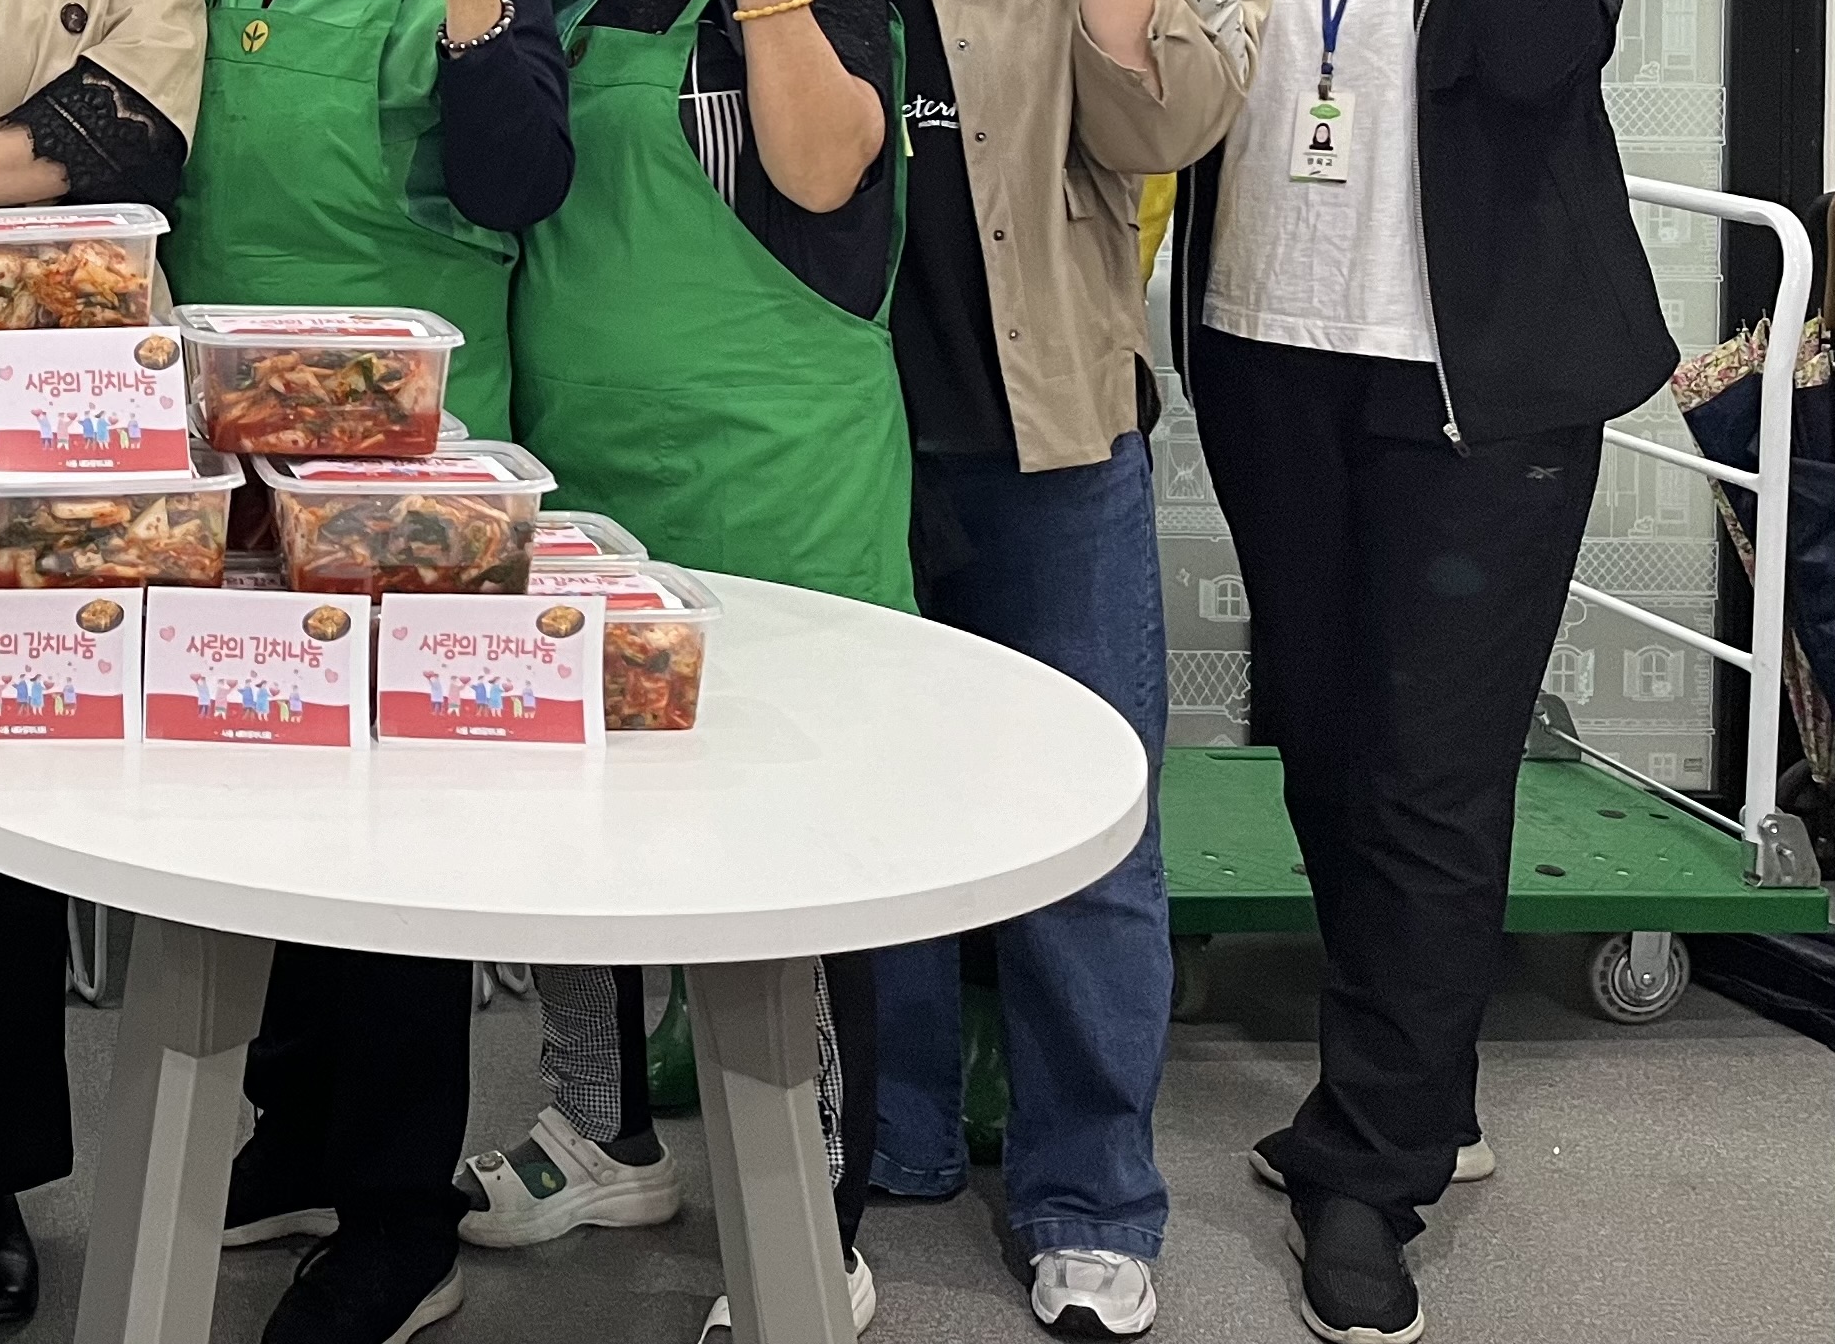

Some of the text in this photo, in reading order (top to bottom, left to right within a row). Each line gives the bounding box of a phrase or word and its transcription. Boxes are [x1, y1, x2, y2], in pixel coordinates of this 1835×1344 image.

[25, 369, 158, 398] 사랑의 김치나눔
[23, 632, 97, 660] 김치나눔
[185, 633, 325, 669] 사랑의 김치나눔
[418, 632, 558, 665] 사랑의 김치나눔
